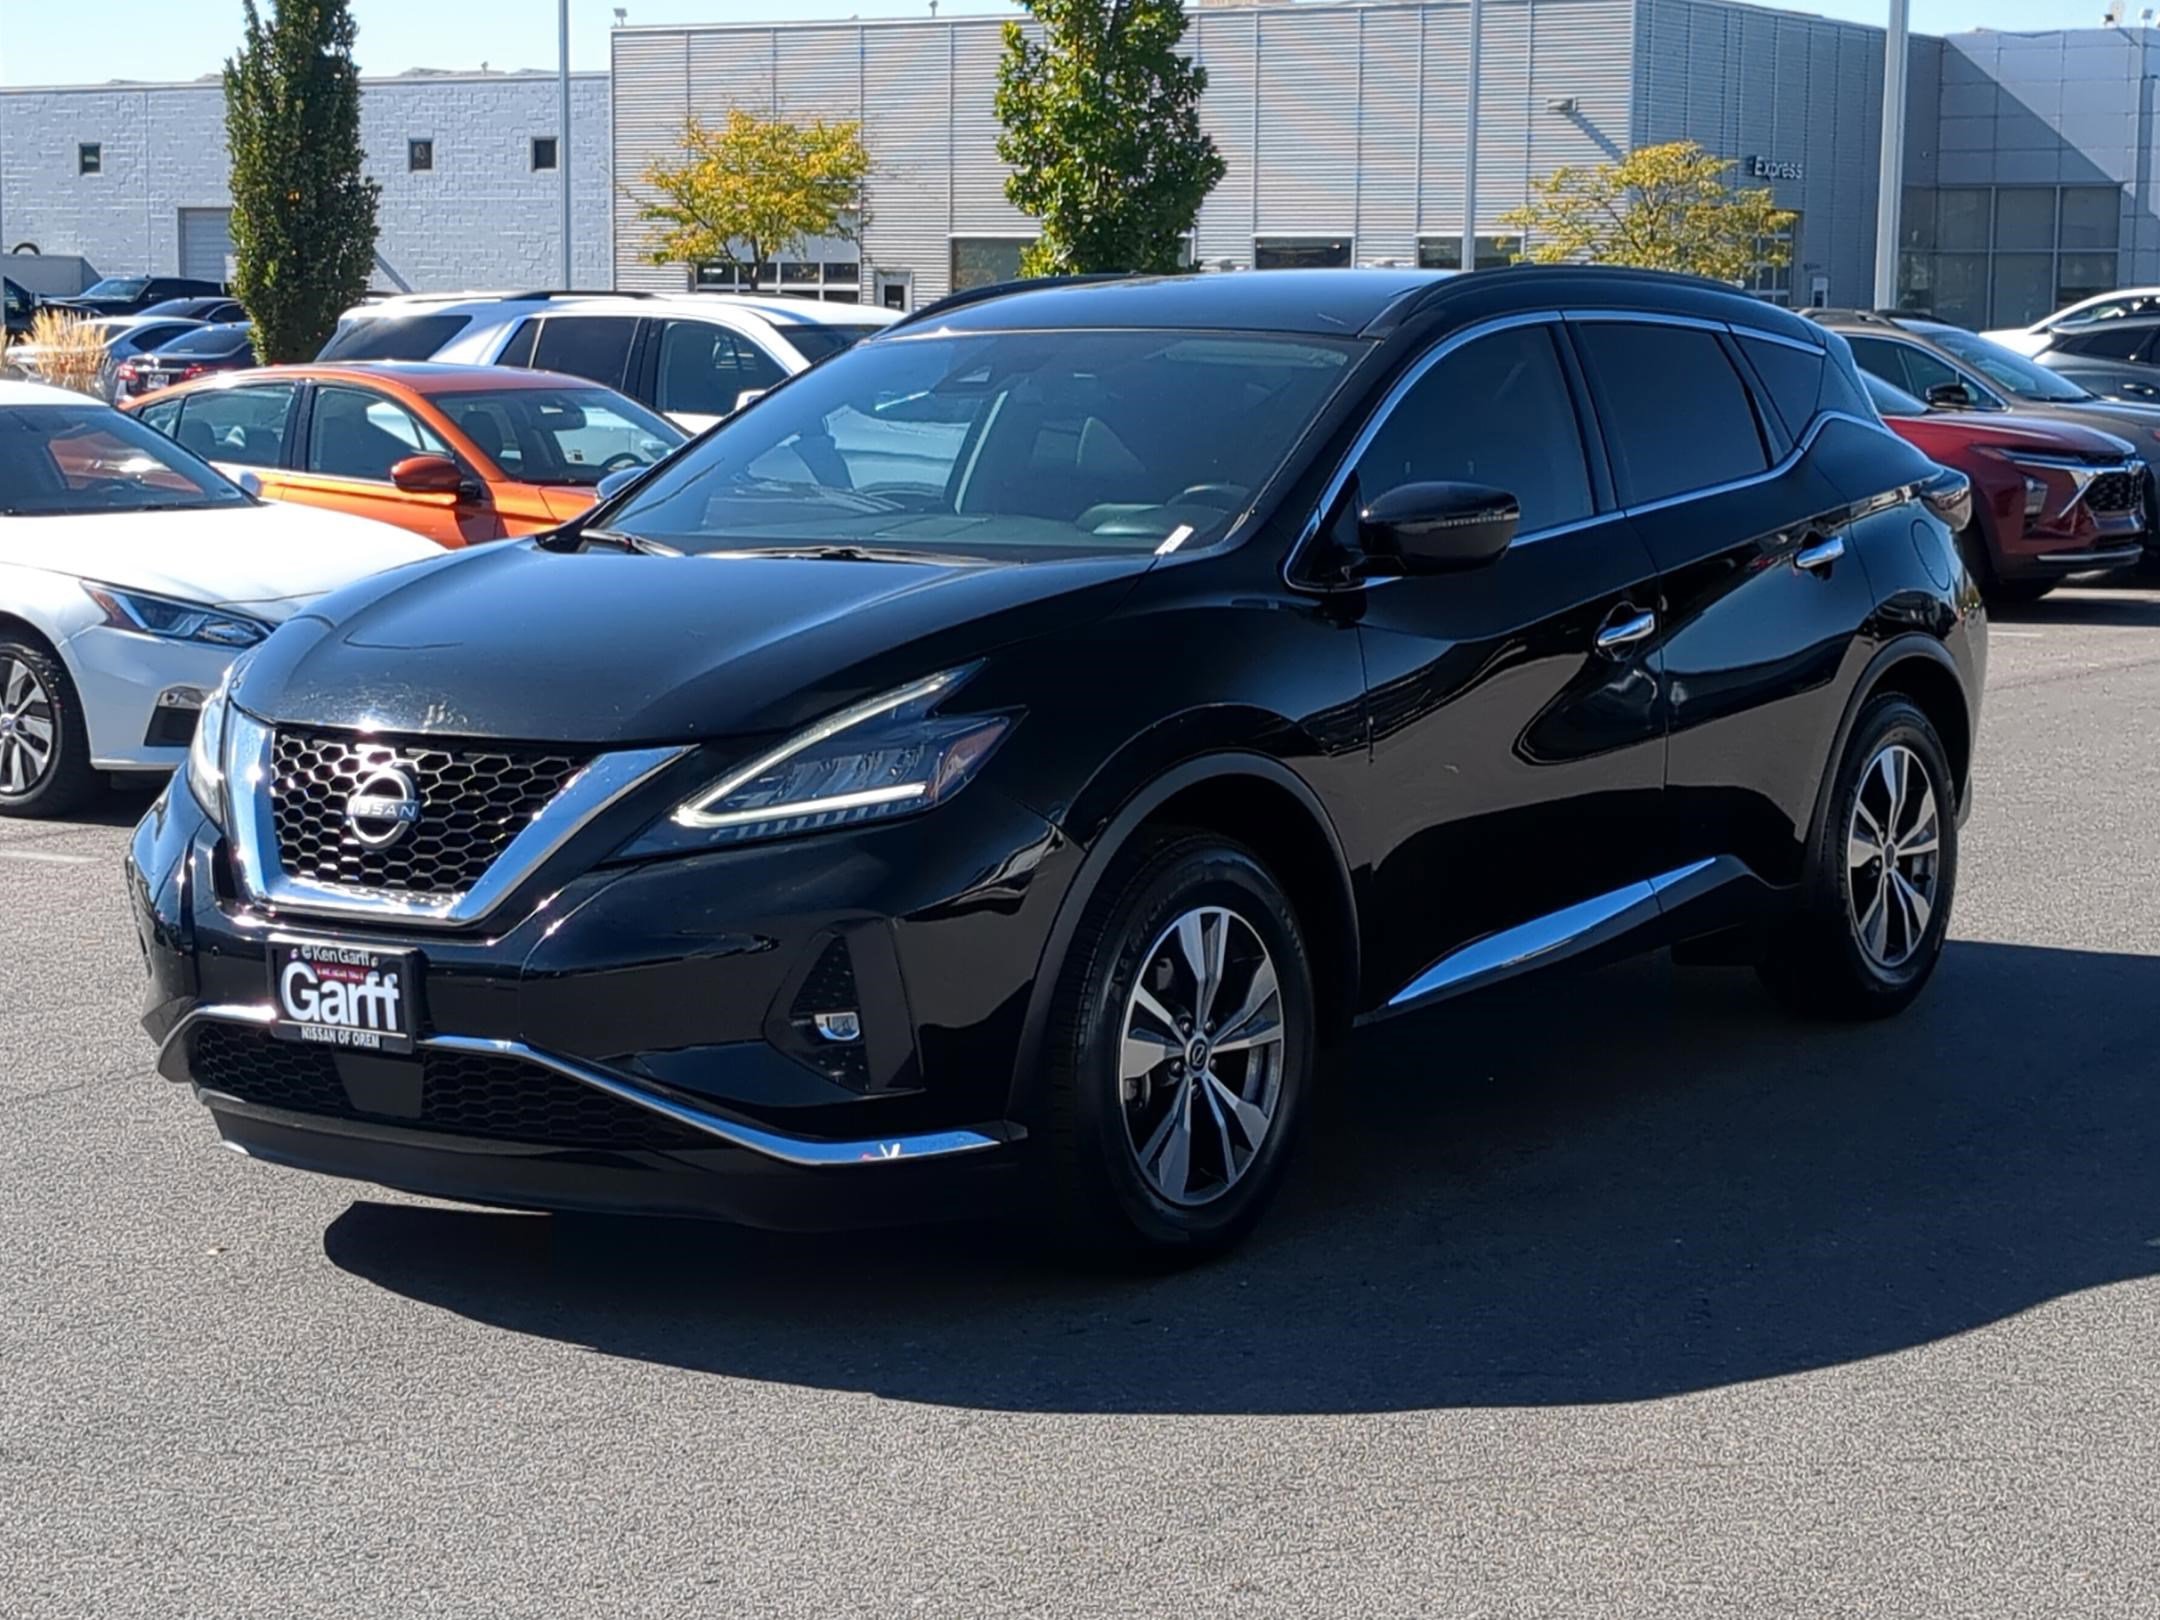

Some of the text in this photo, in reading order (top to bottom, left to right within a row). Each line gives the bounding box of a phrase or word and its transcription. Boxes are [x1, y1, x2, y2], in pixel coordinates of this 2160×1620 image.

[1755, 156, 1803, 179] Express
[312, 946, 370, 967] Ken Garff
[280, 961, 400, 1031] Garff
[302, 1027, 380, 1048] NISSAN OF OREM
